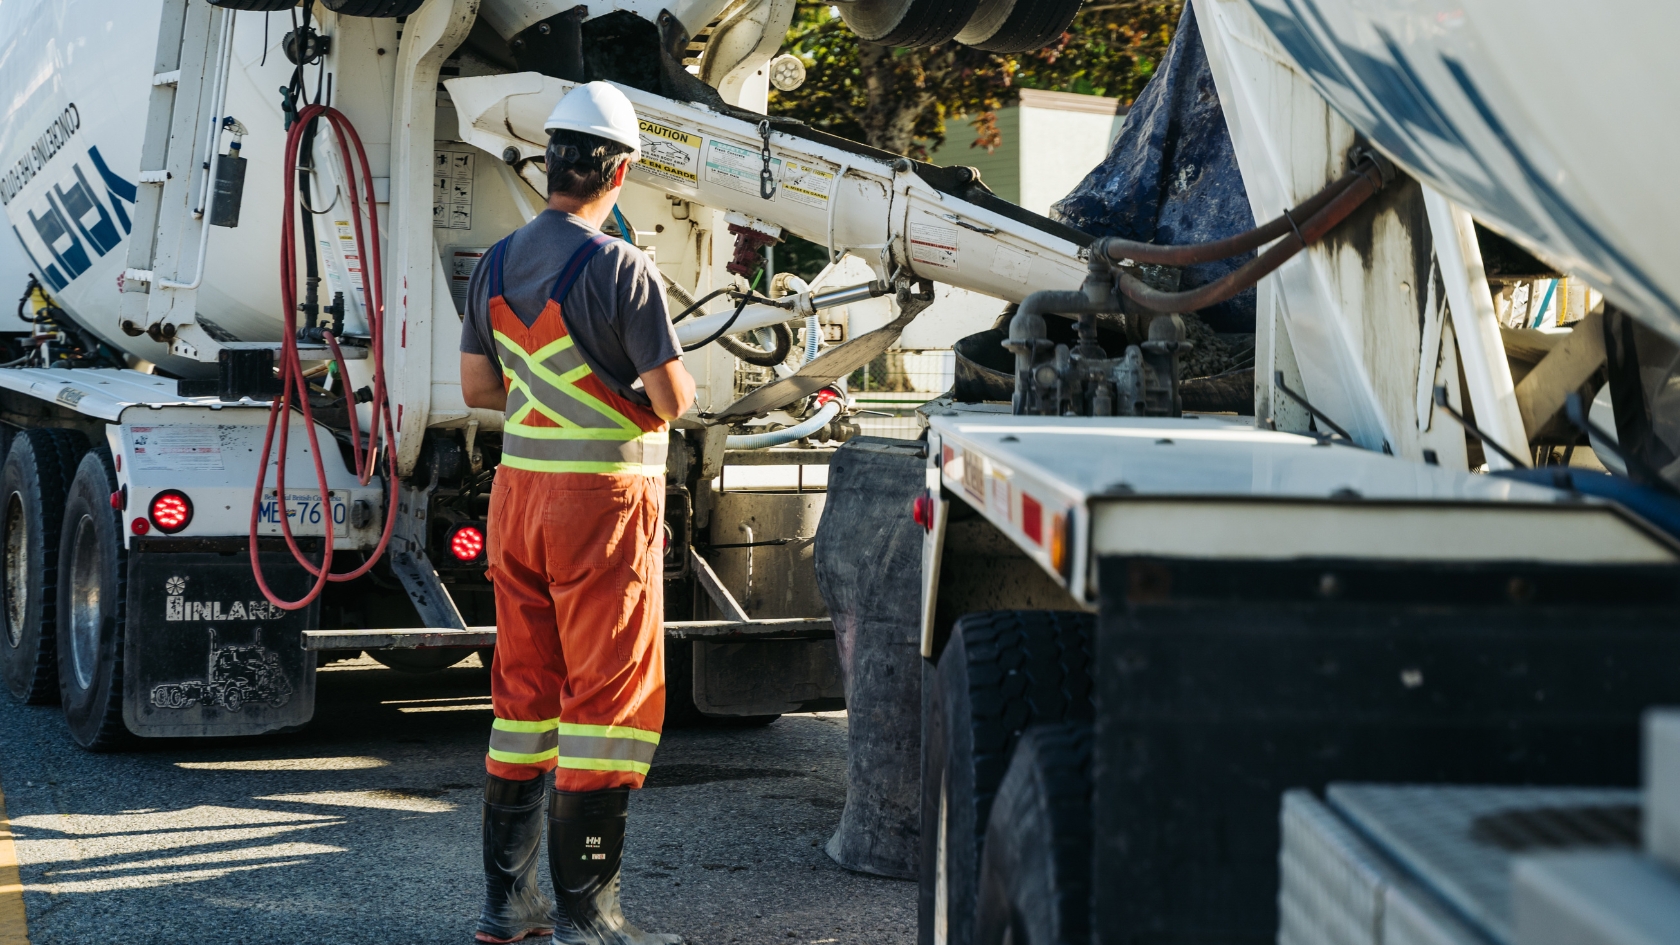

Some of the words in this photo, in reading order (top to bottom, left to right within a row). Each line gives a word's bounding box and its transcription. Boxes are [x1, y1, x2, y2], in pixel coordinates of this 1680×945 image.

[31, 102, 81, 172] CONCRETING
[639, 121, 689, 143] CAUTION
[18, 150, 37, 186] THE
[649, 161, 662, 170] EN
[663, 166, 696, 180] GARDE
[800, 164, 826, 177] CATION
[292, 493, 312, 502] British
[296, 502, 346, 525] 760
[585, 836, 602, 845] HH
